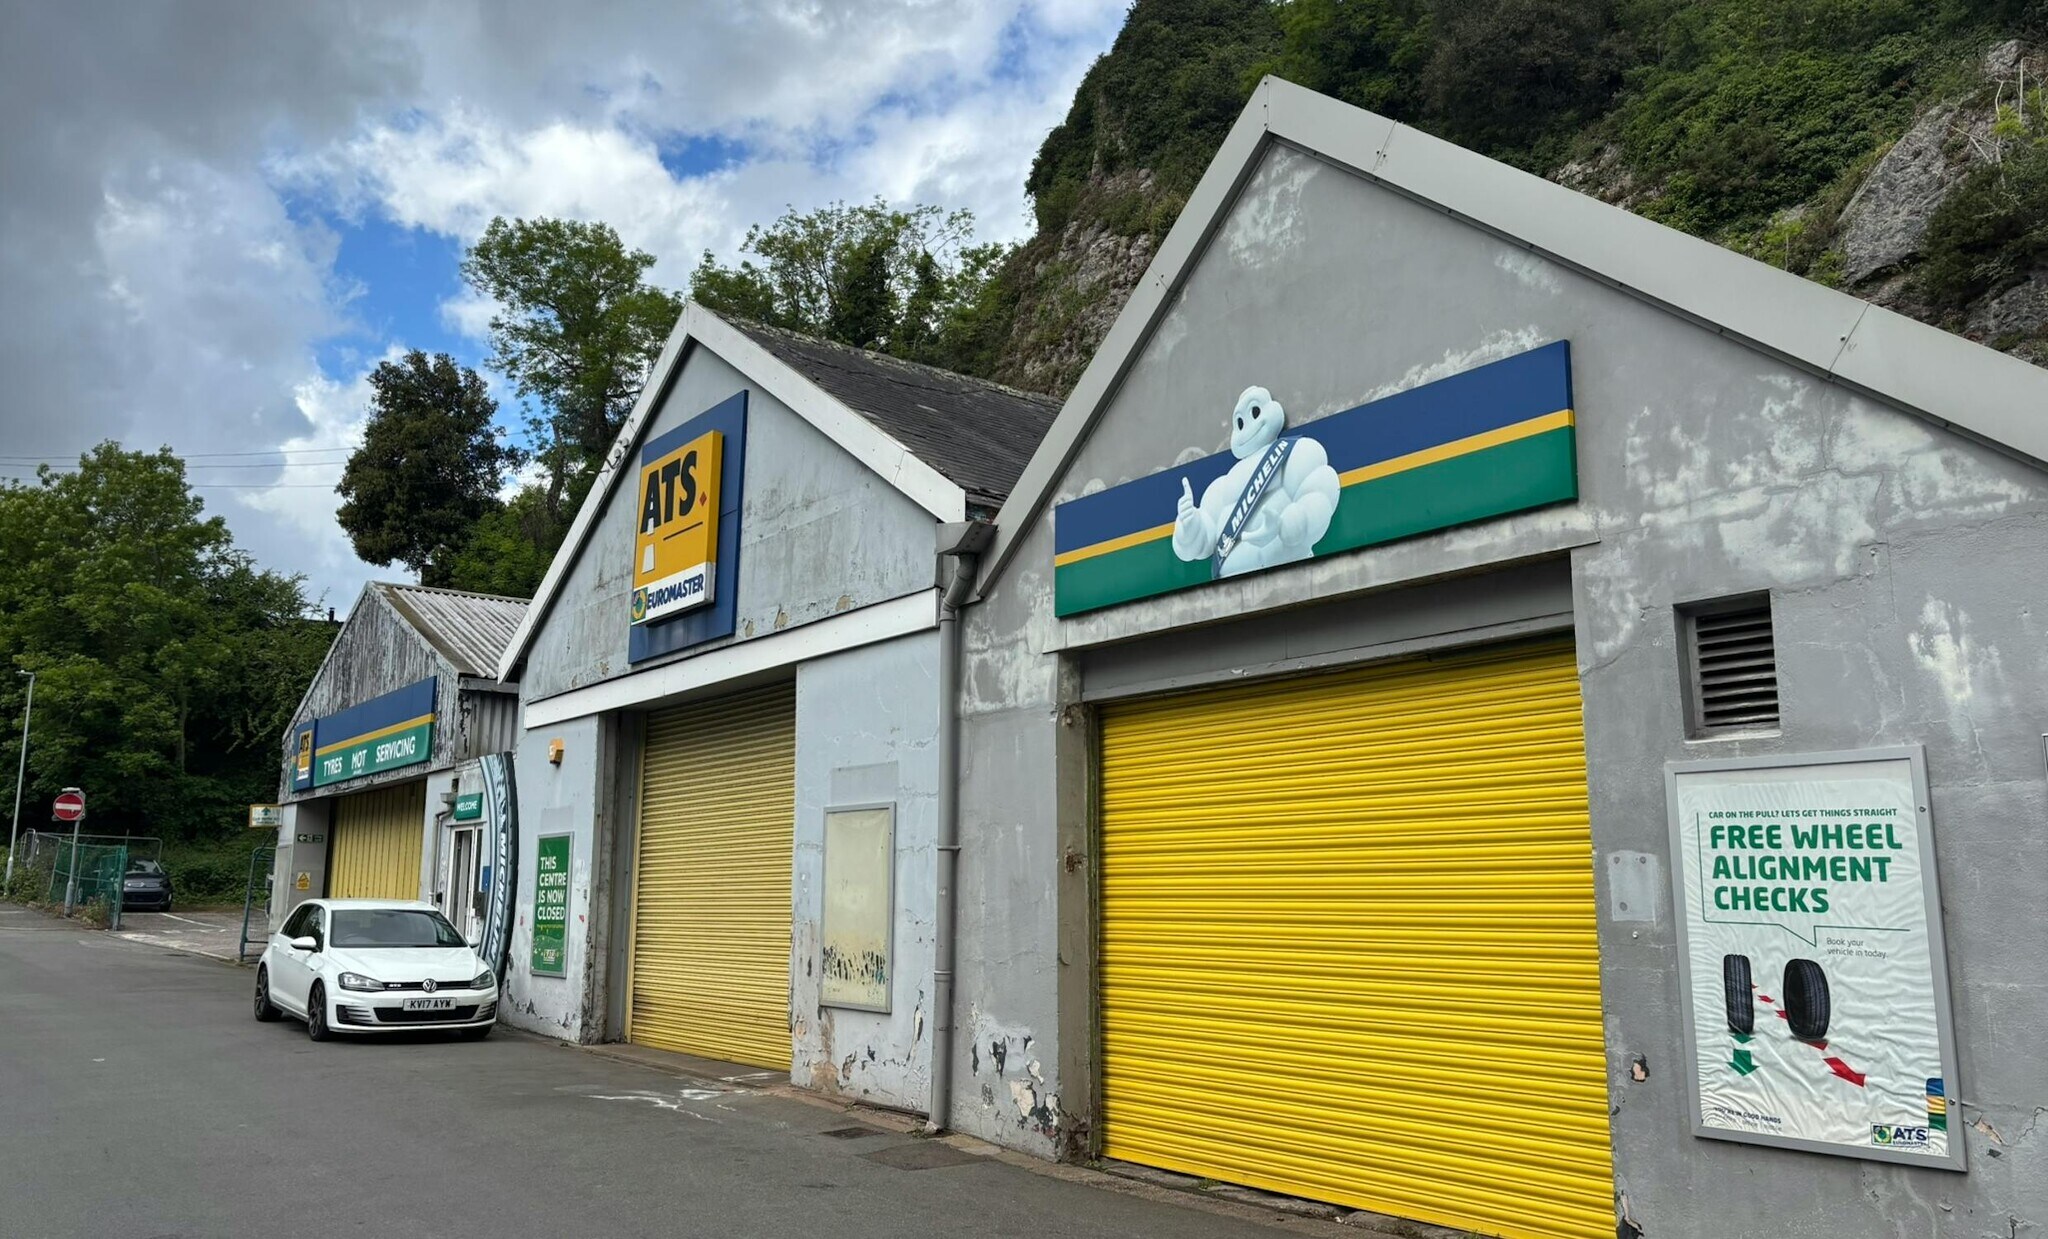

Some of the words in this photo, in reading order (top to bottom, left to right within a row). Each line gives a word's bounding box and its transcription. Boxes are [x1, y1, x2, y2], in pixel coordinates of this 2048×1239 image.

[640, 451, 698, 534] ATS
[1231, 439, 1288, 532] MICHELIN
[646, 573, 705, 610] EUROMASTER
[323, 756, 343, 777] TYRES
[351, 749, 368, 770] MOT
[375, 735, 416, 763] SERVICING
[456, 800, 478, 811] WELCOME
[1708, 811, 1724, 819] CAR
[1726, 811, 1737, 819] ON
[1755, 810, 1779, 818] PULL?
[1781, 810, 1800, 818] LETS
[1802, 809, 1818, 817] GET
[1820, 809, 1851, 817] THINGS
[1853, 808, 1897, 817] STRAIGHT
[1710, 825, 1783, 849] FREE
[1790, 823, 1903, 850] WHEEL
[540, 856, 557, 871] THIS
[1712, 855, 1892, 882] ALIGNMENT
[539, 872, 567, 887] CENTRE
[538, 890, 546, 903] IS
[547, 889, 565, 904] NOW
[1714, 886, 1830, 913] CHECKS
[537, 906, 565, 921] CLOSED
[1826, 937, 1845, 946] Book
[1827, 948, 1854, 956] vehicle
[410, 1000, 431, 1009] KV17
[1761, 1115, 1782, 1124] HANDS
[1893, 1127, 1927, 1141] ATS
